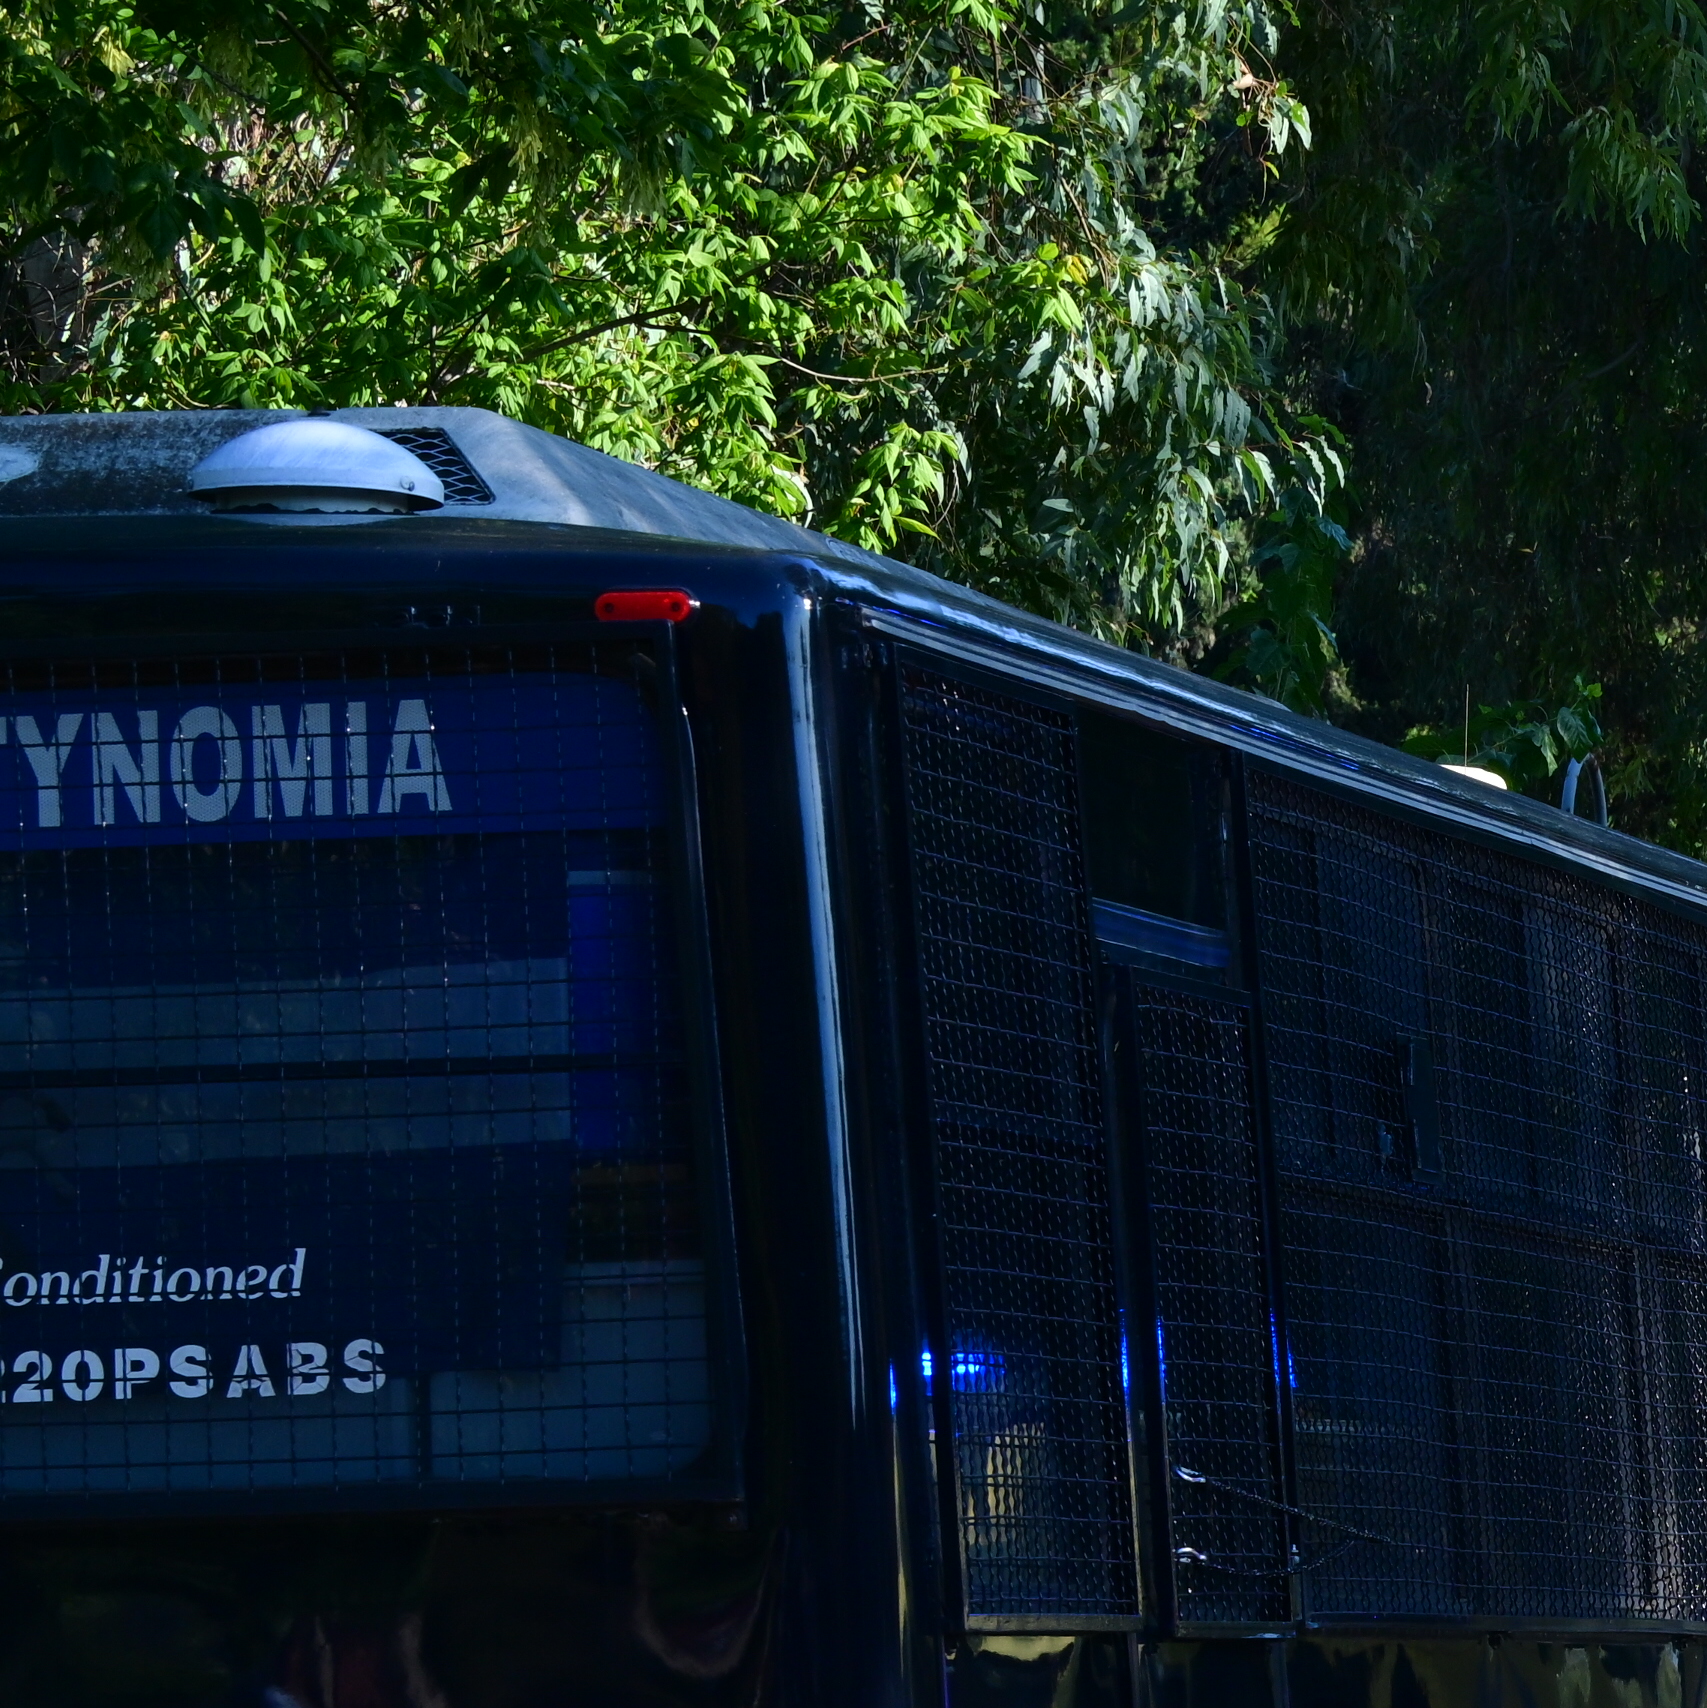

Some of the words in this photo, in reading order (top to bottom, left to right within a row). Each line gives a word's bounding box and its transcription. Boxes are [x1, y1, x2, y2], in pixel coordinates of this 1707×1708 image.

[0, 699, 453, 828] ΥΝΟΜΙΑ
[0, 1248, 307, 1307] onditioned
[0, 1345, 214, 1404] 20PS
